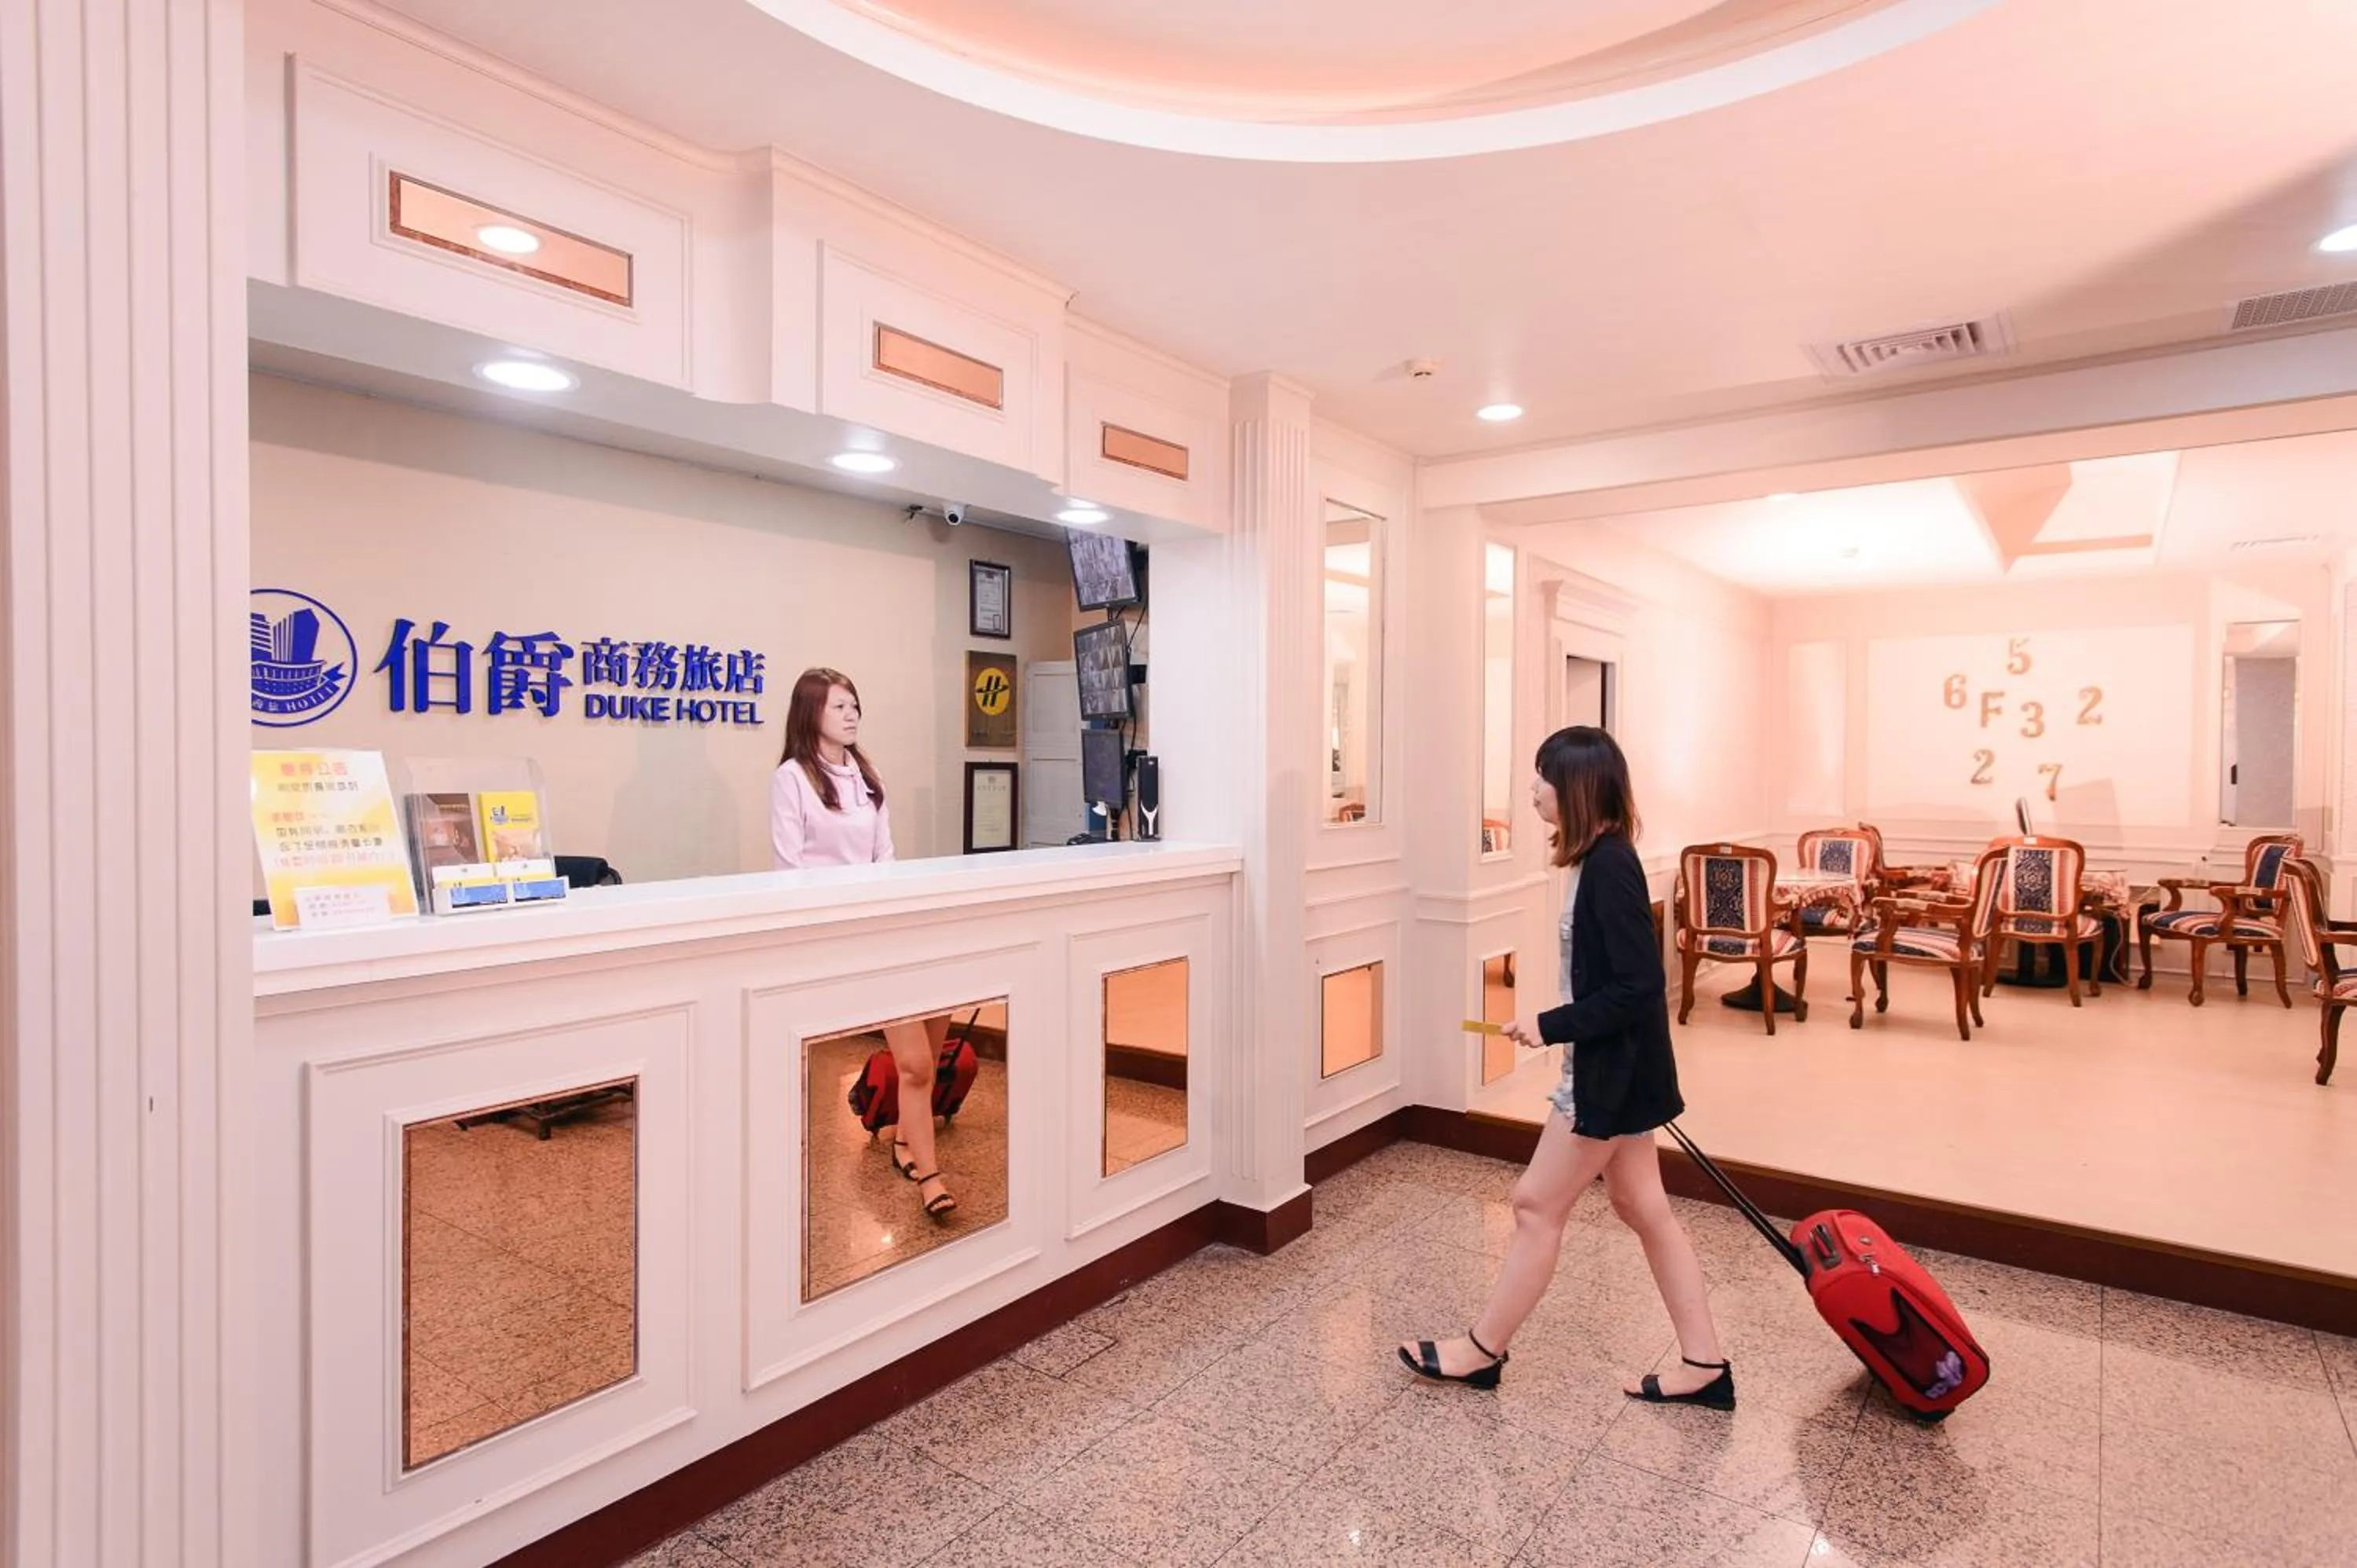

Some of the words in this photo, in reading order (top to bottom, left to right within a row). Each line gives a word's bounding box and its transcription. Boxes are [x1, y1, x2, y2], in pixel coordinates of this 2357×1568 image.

[373, 618, 574, 717] 伯爵
[581, 637, 765, 694] 商務旅店
[2007, 637, 2033, 675] 5
[585, 694, 670, 722] DUKE
[676, 699, 764, 724] HOTEL
[1943, 674, 1967, 709] 6
[1980, 691, 2005, 728] F
[2020, 702, 2045, 738] 3
[2077, 686, 2103, 725] 2
[1970, 749, 1995, 785] 2
[2038, 764, 2063, 801] 7
